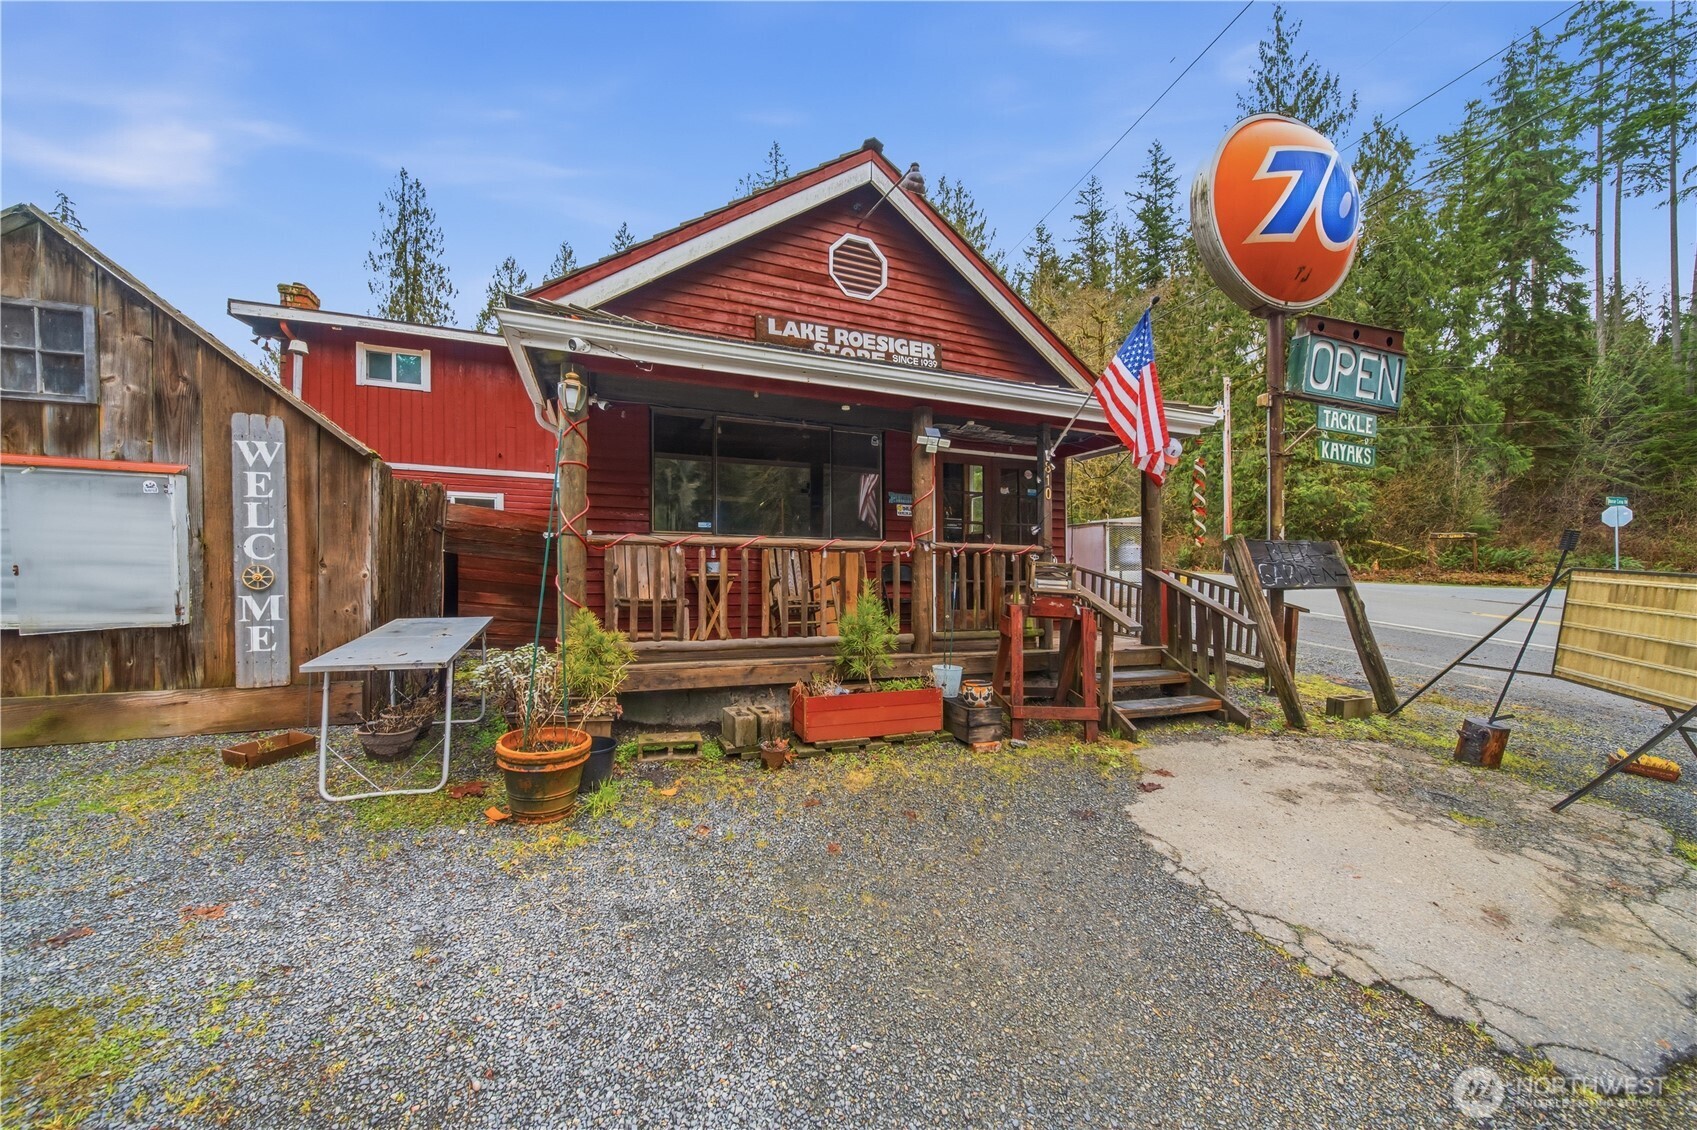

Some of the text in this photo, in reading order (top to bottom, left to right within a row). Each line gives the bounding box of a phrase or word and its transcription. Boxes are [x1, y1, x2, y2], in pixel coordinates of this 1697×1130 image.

[1243, 145, 1361, 252] 76
[768, 317, 936, 359] LAKE ROESIGER
[892, 354, 938, 369] SINCE 1939
[1308, 340, 1403, 404] OPEN
[1323, 409, 1373, 435] TACKLE
[1321, 440, 1372, 465] KAYAKS
